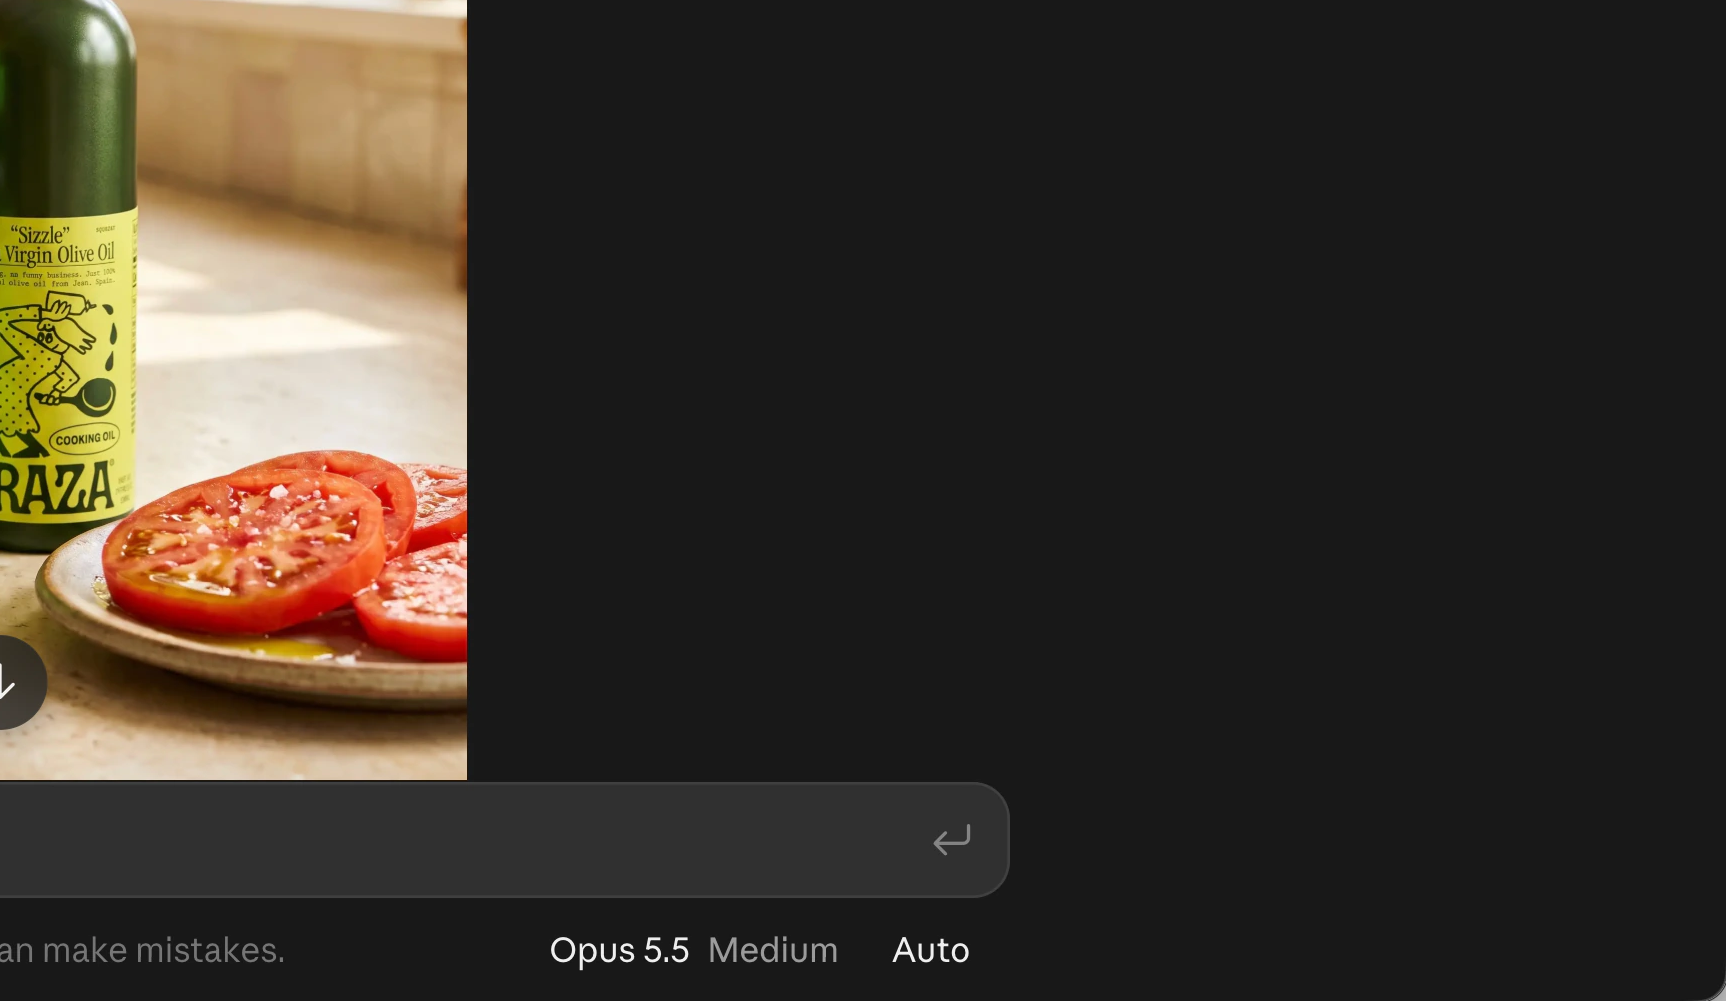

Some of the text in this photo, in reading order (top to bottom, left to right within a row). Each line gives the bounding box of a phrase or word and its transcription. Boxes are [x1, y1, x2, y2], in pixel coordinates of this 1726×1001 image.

[11, 225, 70, 244] “Sizzle”
[5, 245, 53, 268] Virgin
[58, 244, 94, 264] Olive
[98, 241, 115, 261] Oil
[56, 431, 116, 446] COOKING OIL
[44, 936, 127, 963] make
[138, 936, 283, 963] mistakes.
[551, 936, 837, 971] Opus 5.5 Medium
[892, 937, 969, 963] Auto
